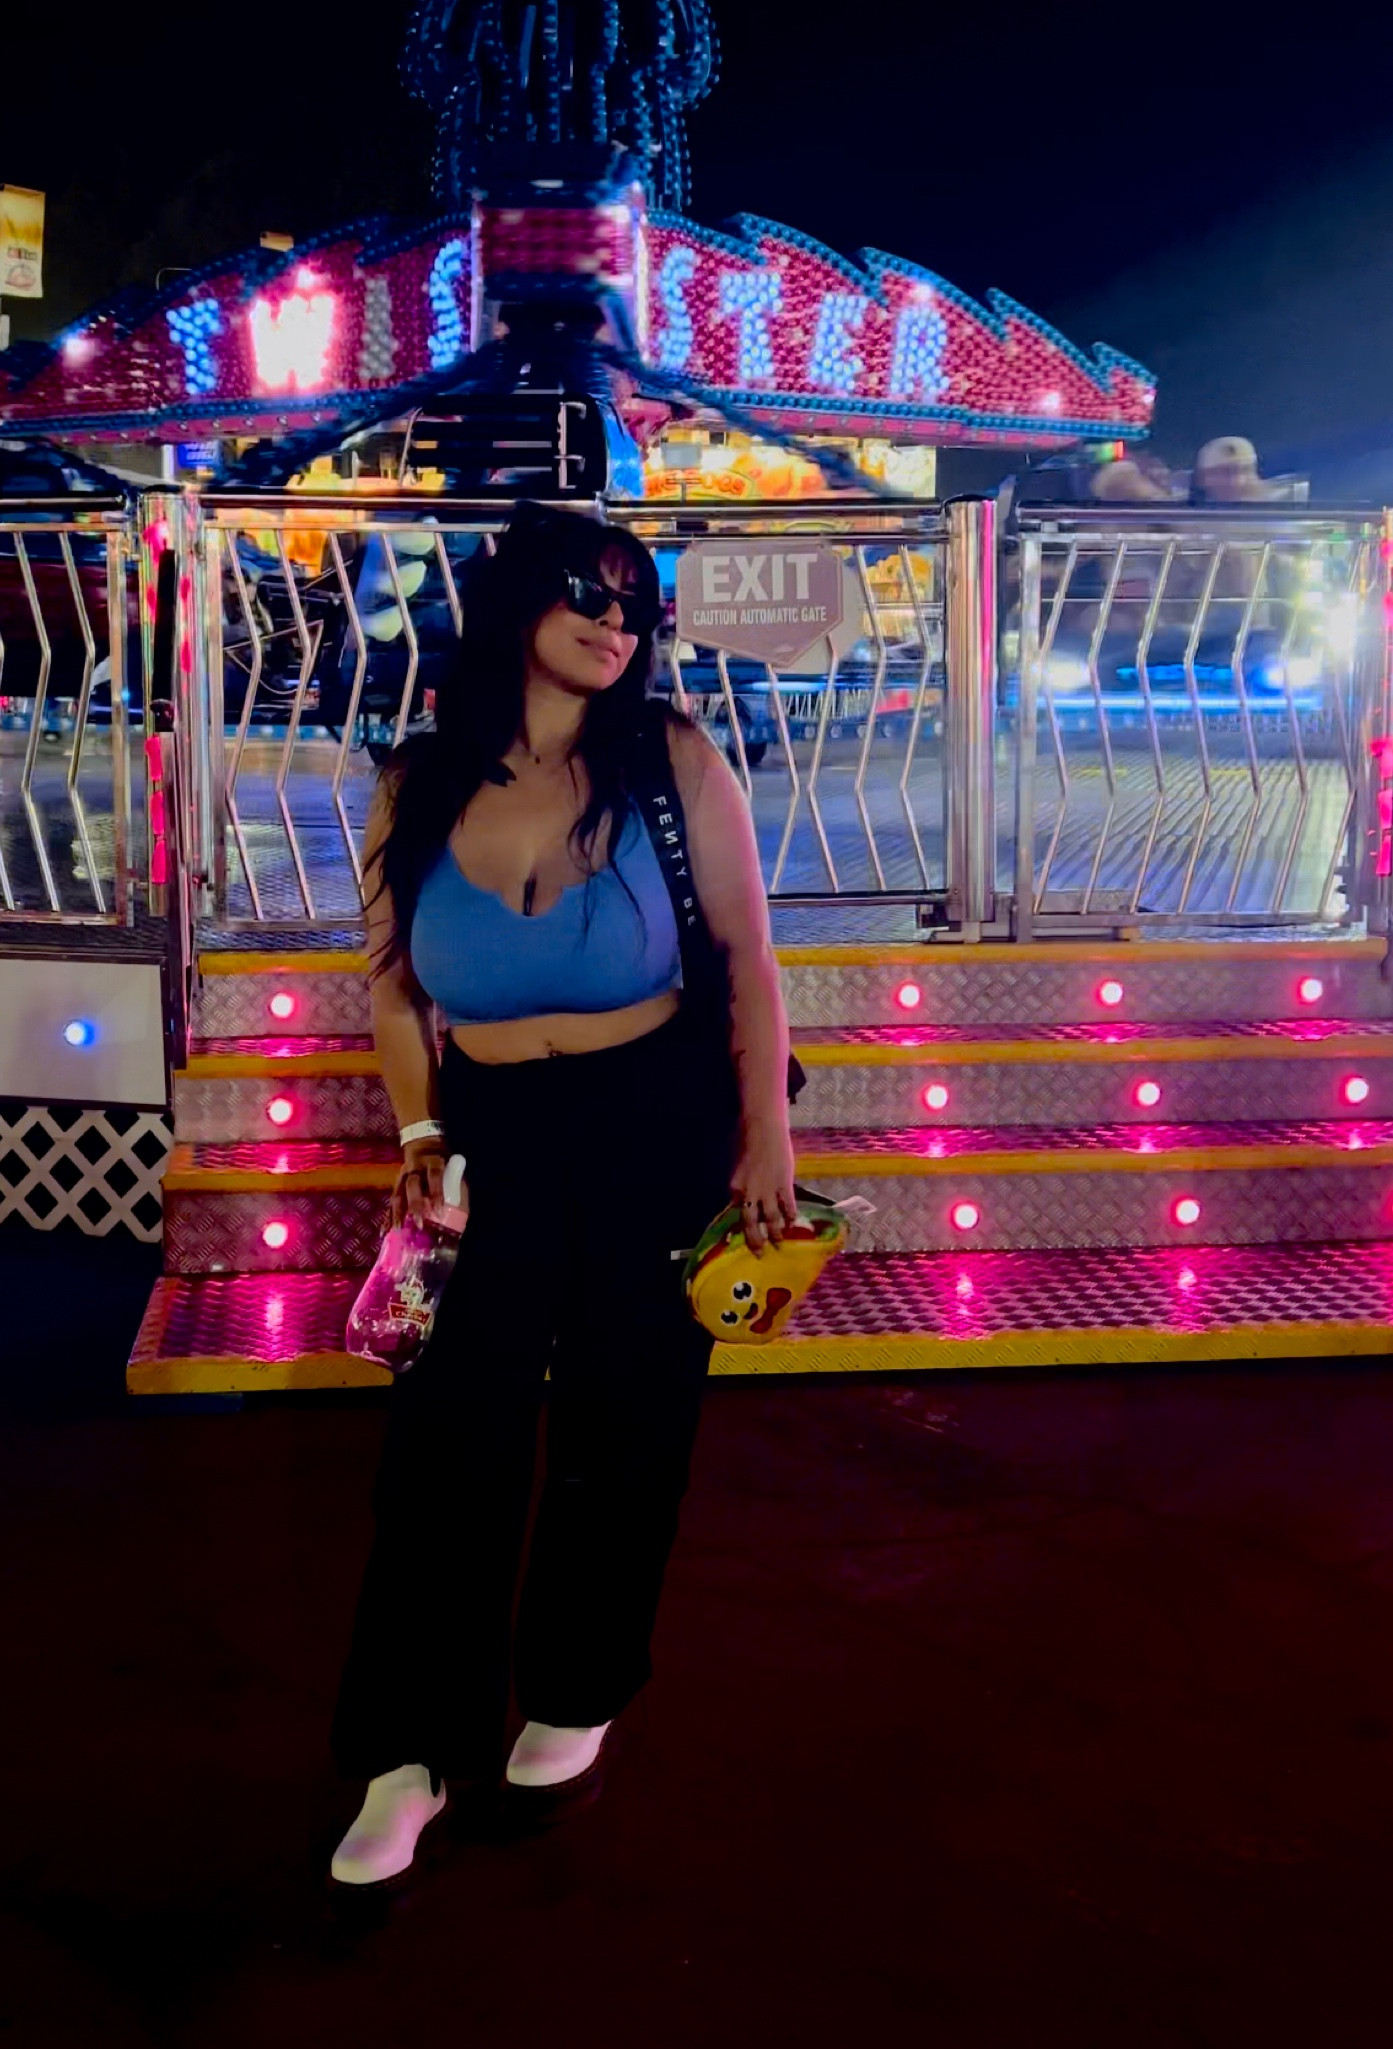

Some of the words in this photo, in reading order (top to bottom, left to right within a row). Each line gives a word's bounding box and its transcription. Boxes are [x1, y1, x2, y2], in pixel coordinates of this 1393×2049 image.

[702, 554, 818, 603] EXIT
[693, 609, 737, 626] CAUTION
[740, 606, 799, 625] AUTOMATIC
[801, 605, 827, 622] GATE
